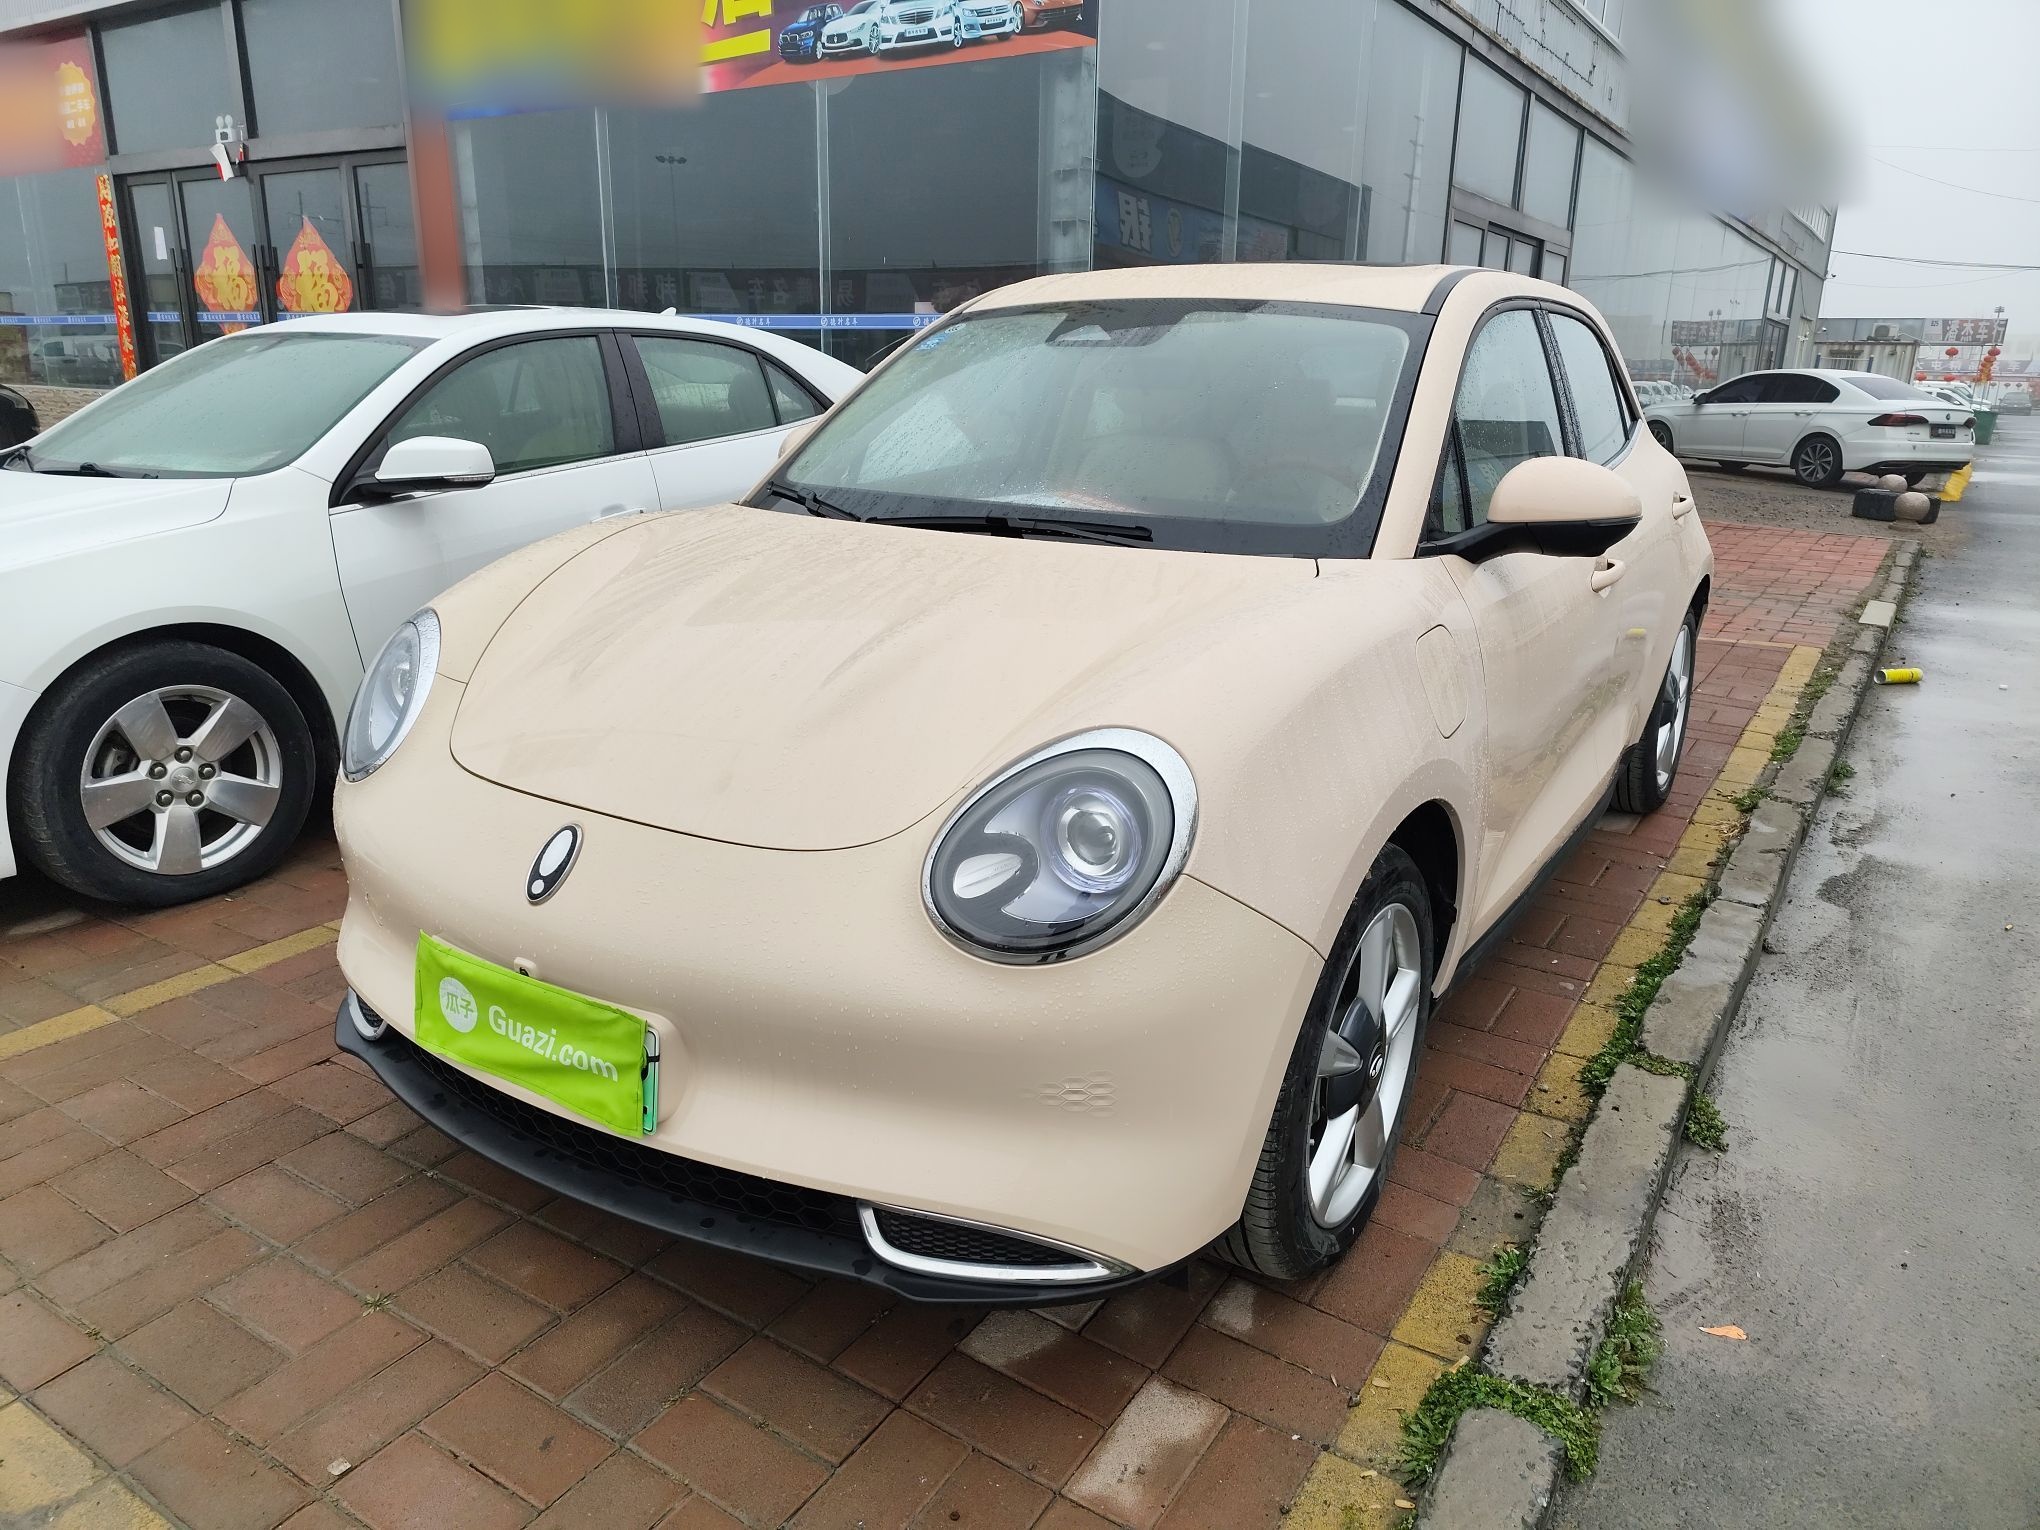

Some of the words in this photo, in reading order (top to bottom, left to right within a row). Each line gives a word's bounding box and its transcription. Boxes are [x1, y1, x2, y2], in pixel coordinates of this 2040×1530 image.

[213, 246, 248, 311] 福
[295, 249, 338, 312] 福
[446, 992, 474, 1018] 瓜子
[488, 1005, 618, 1081] Guazi.com
